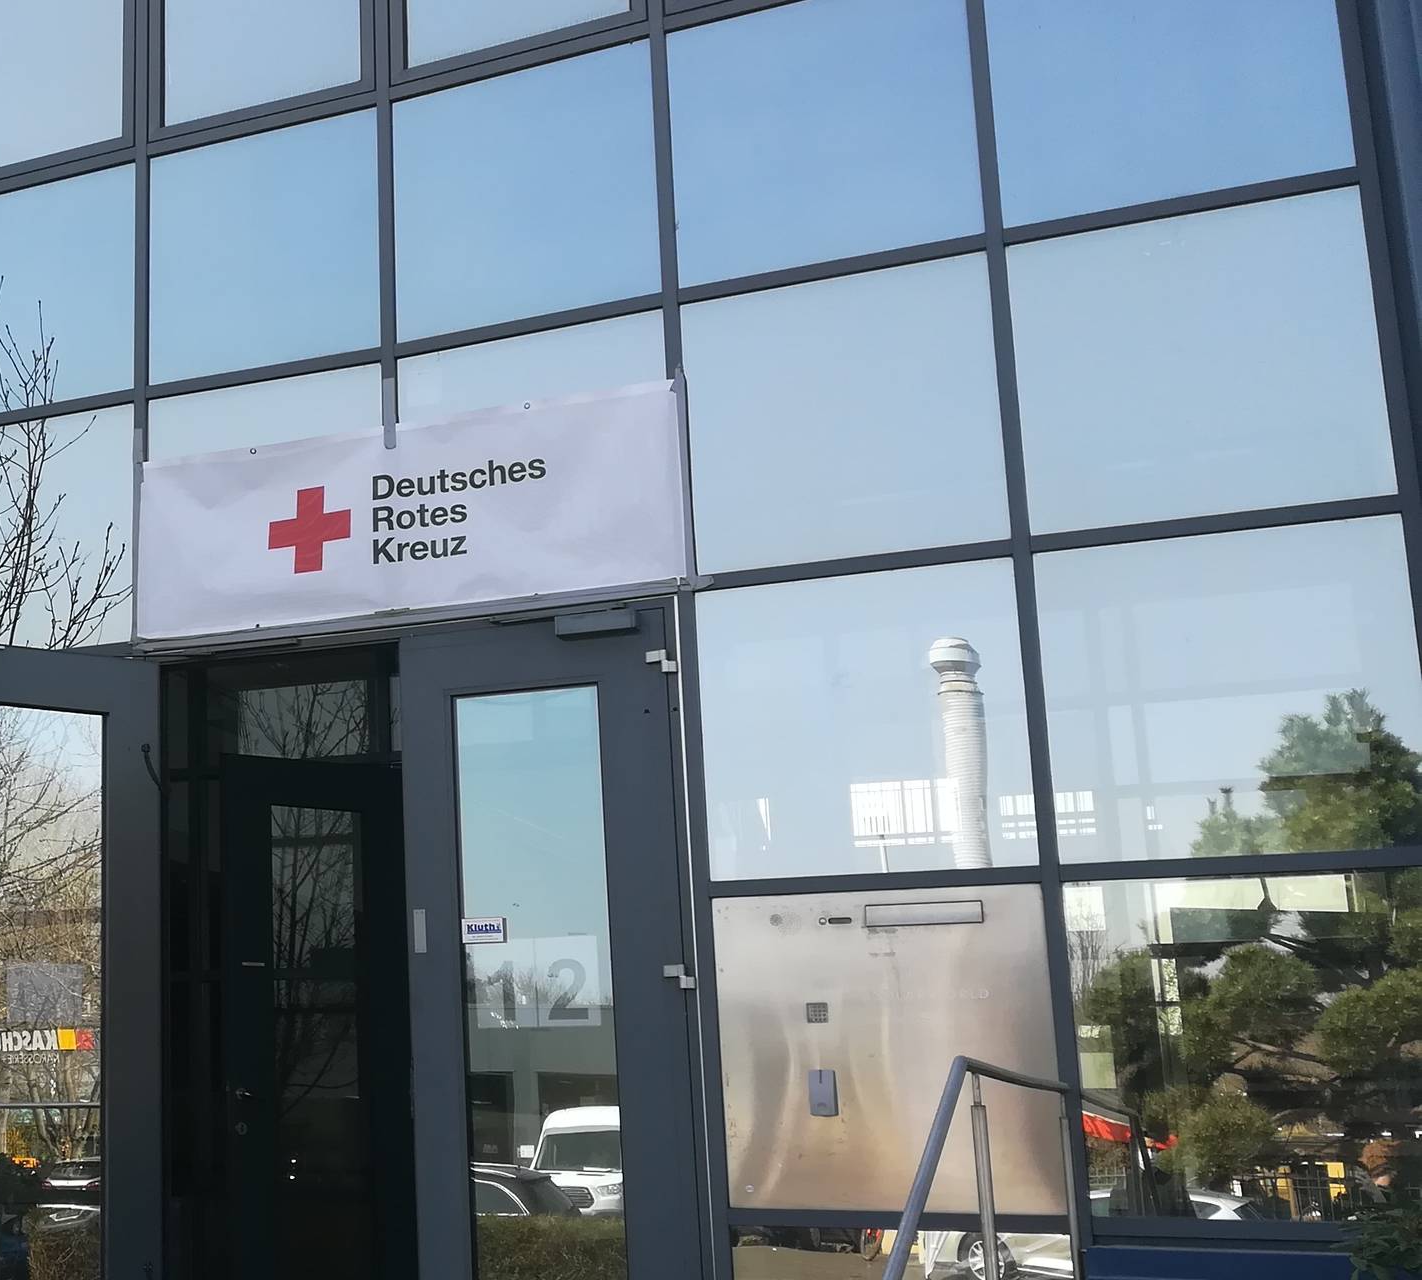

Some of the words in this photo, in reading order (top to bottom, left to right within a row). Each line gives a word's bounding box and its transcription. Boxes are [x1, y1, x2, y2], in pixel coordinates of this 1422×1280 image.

[372, 457, 547, 500] Deutsches
[372, 503, 468, 532] Rotes
[372, 535, 468, 565] Kreuz
[487, 958, 590, 1021] 12
